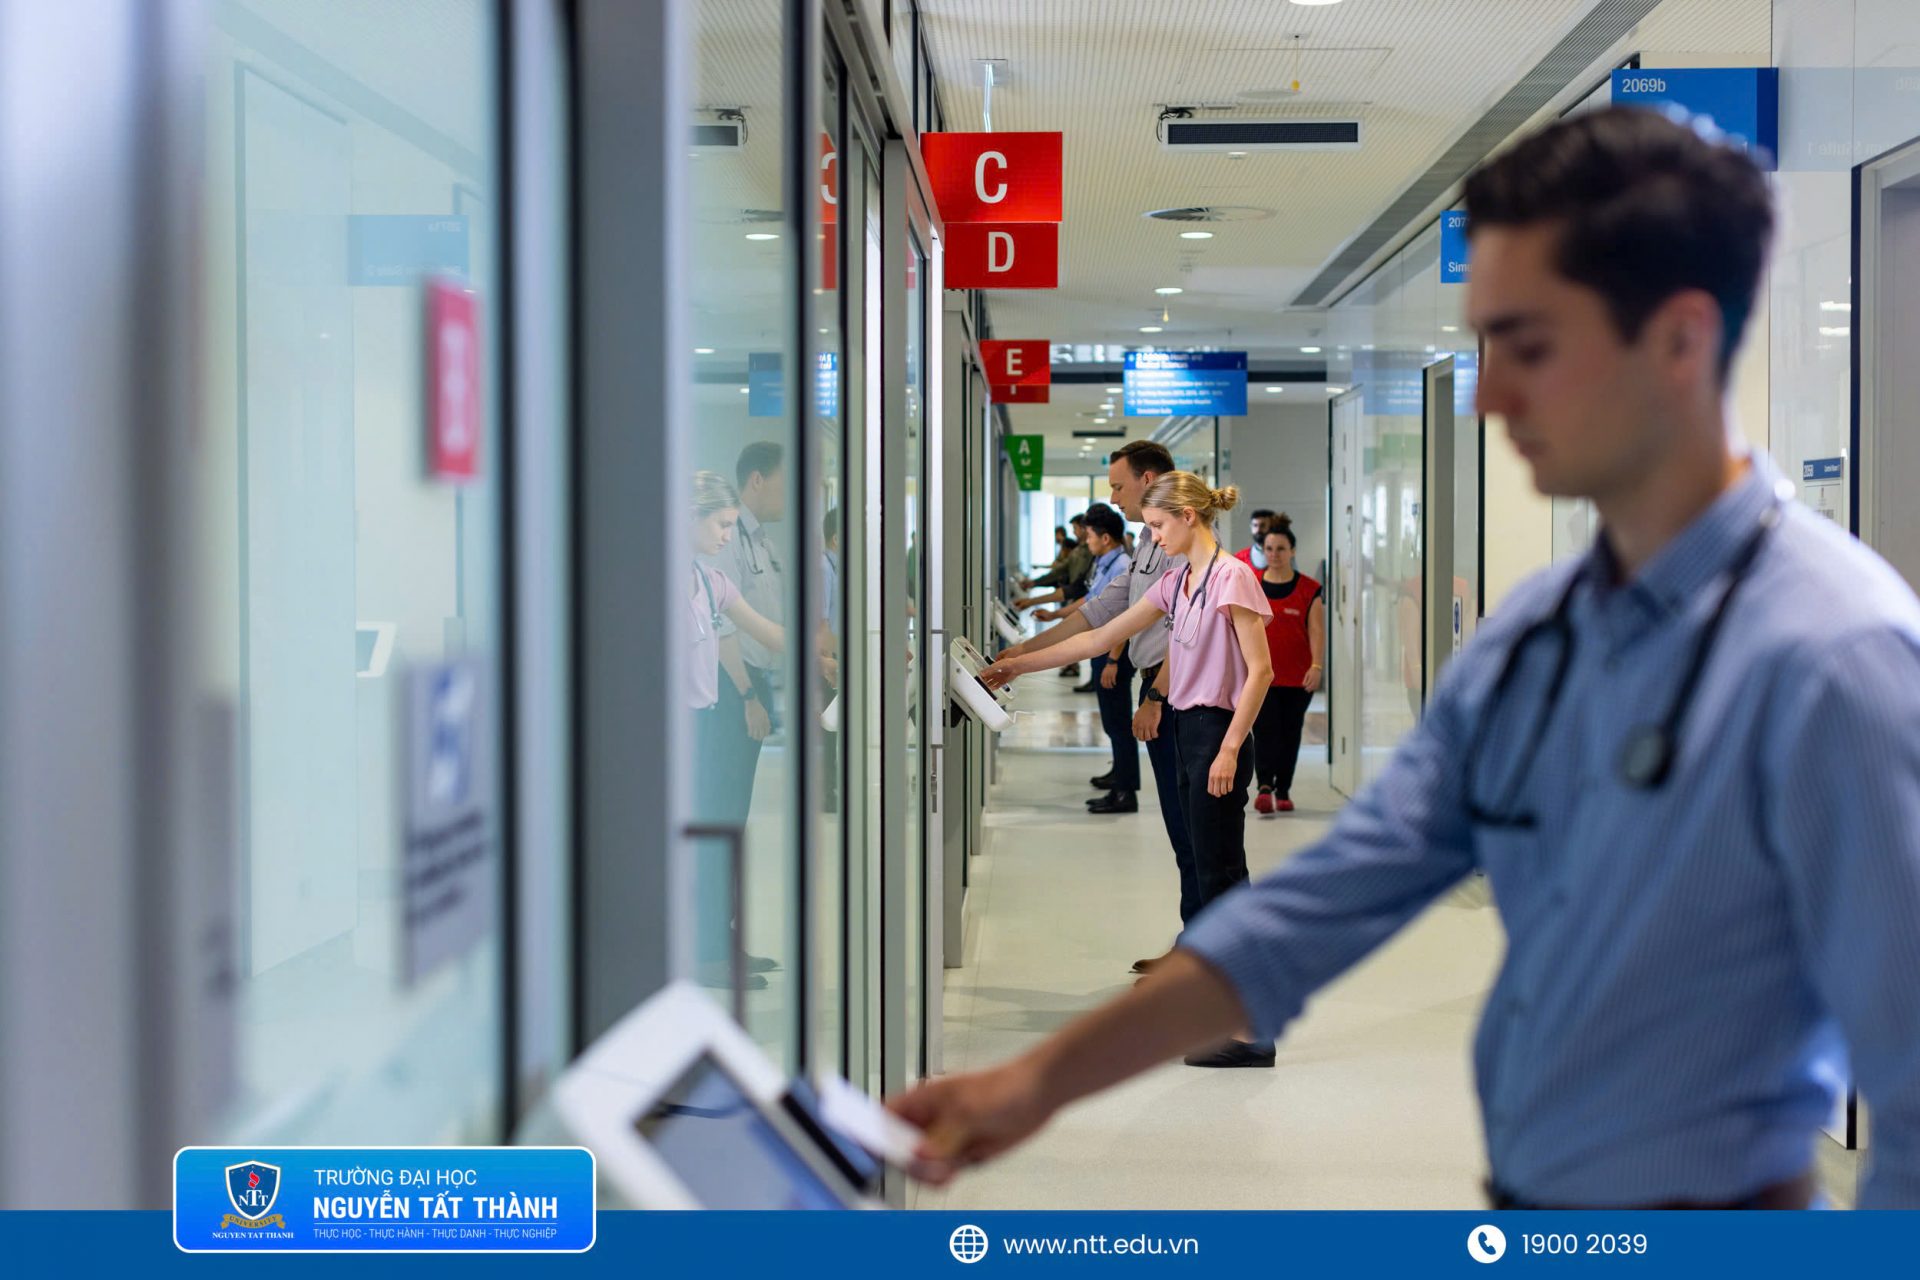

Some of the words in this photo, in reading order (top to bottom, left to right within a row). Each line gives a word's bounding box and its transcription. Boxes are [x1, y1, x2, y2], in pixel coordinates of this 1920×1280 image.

[1622, 78, 1666, 93] 2069b
[975, 150, 1008, 204] C
[988, 231, 1015, 273] D
[1006, 348, 1023, 376] E
[1018, 439, 1030, 455] A
